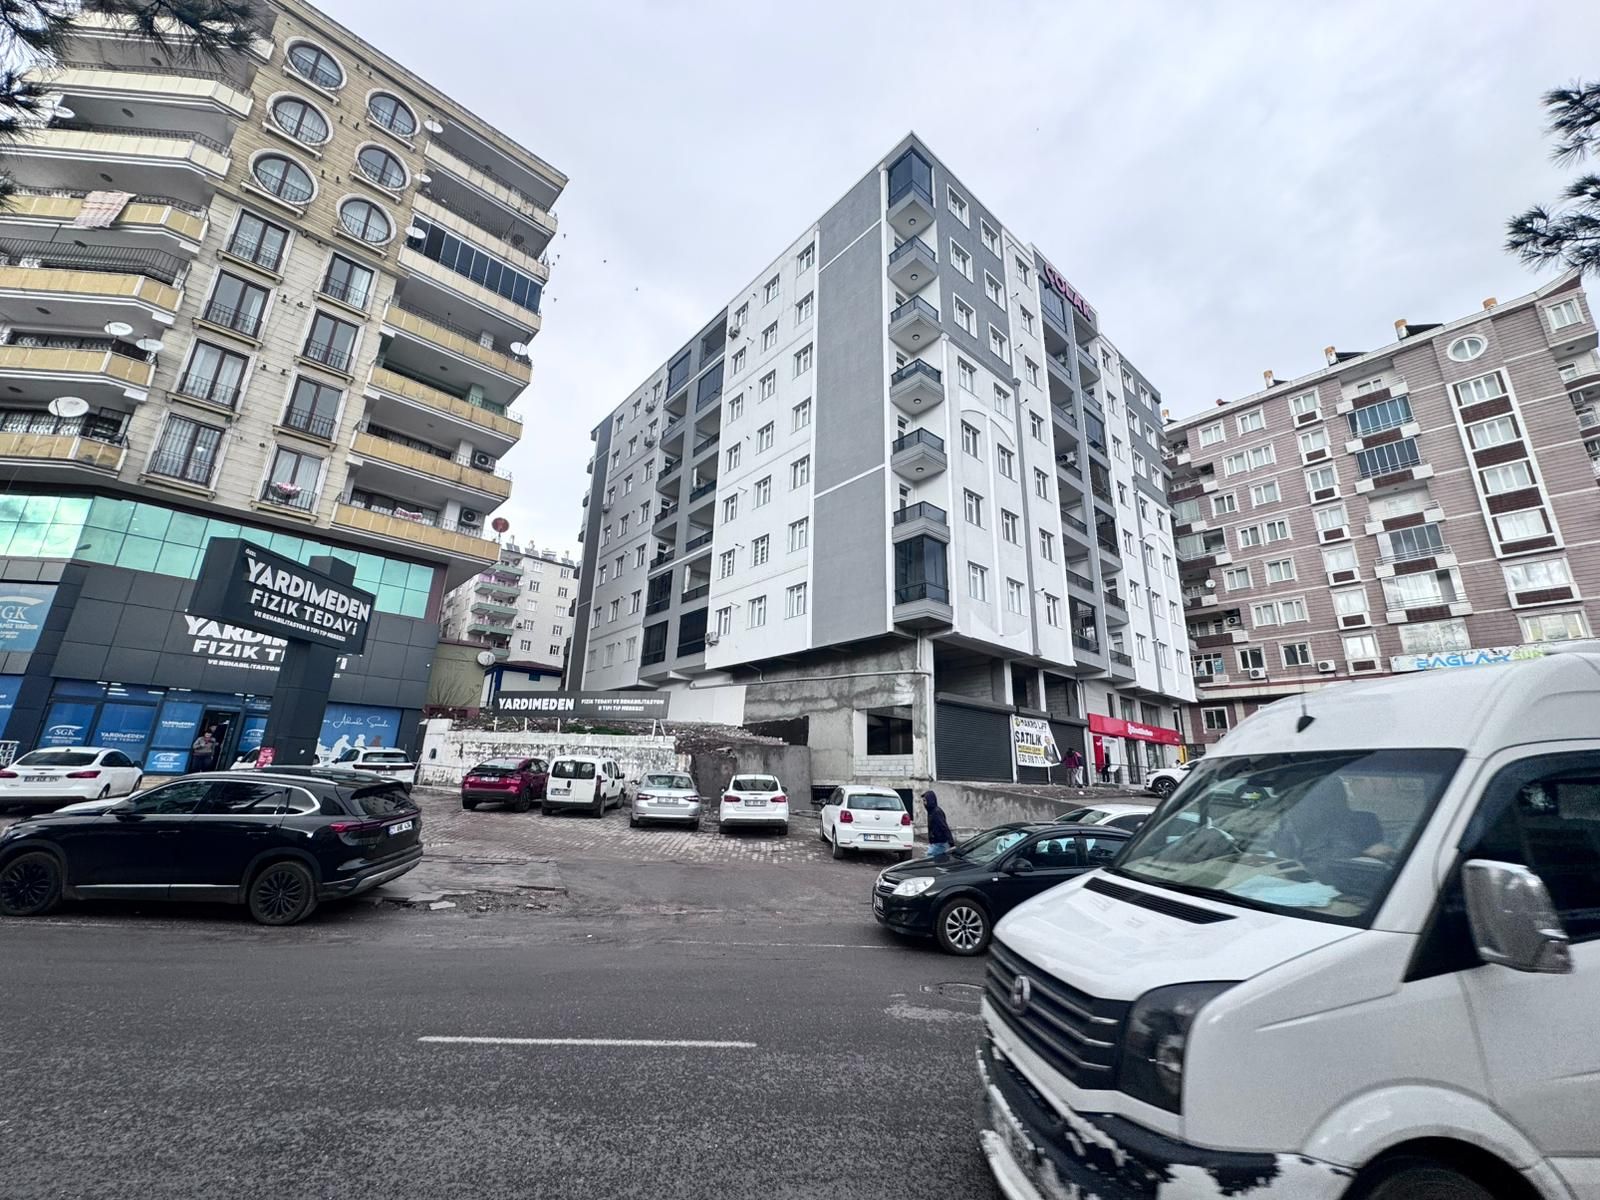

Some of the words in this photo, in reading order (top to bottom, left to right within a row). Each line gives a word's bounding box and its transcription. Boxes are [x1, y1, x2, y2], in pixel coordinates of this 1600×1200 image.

[247, 557, 371, 623] YARDIMEDEN
[254, 610, 261, 618] VE
[498, 698, 574, 711] YARDIMEDEN
[1015, 730, 1042, 747] SATILIK
